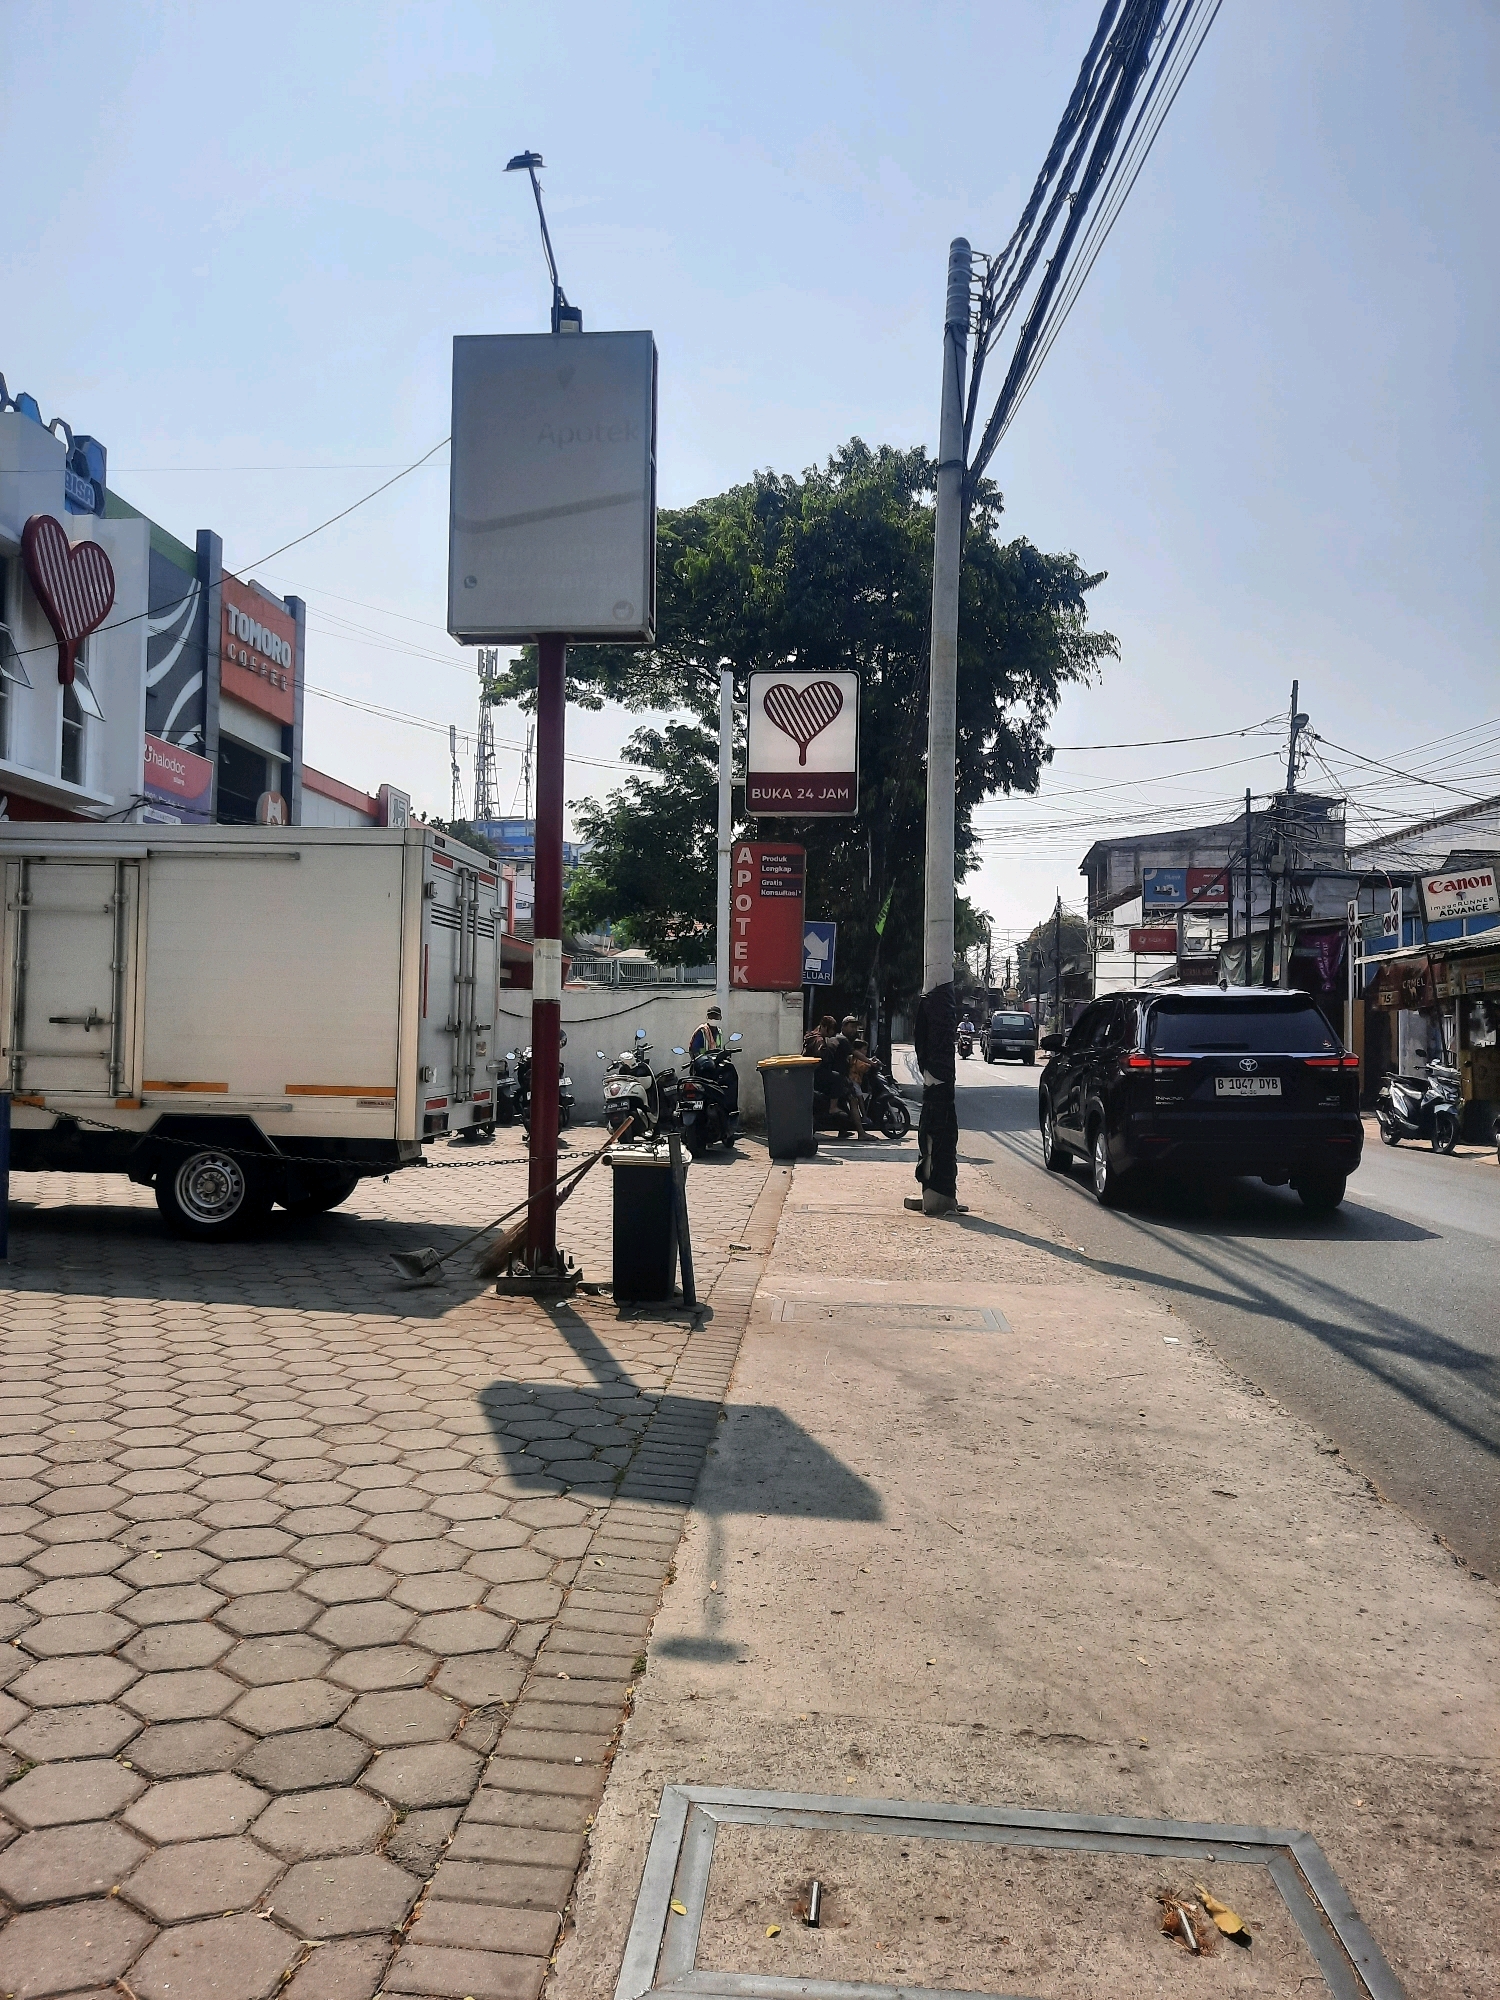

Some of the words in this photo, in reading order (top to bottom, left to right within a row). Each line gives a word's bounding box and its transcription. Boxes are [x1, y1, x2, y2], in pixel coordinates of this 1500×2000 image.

[538, 420, 640, 449] Apotek
[227, 603, 292, 669] TOMORO
[152, 749, 186, 776] halodoc
[751, 788, 793, 799] BUKA
[796, 788, 815, 799] 24
[818, 788, 849, 799] JAM
[761, 865, 792, 874] Lengkap
[761, 879, 783, 887] Gratis
[1427, 874, 1493, 894] Canon
[733, 847, 754, 984] APOTEK
[1439, 903, 1490, 918] ADVANCE
[1402, 977, 1426, 989] CAMEL
[1217, 1079, 1225, 1090] B
[1228, 1079, 1254, 1090] 1047
